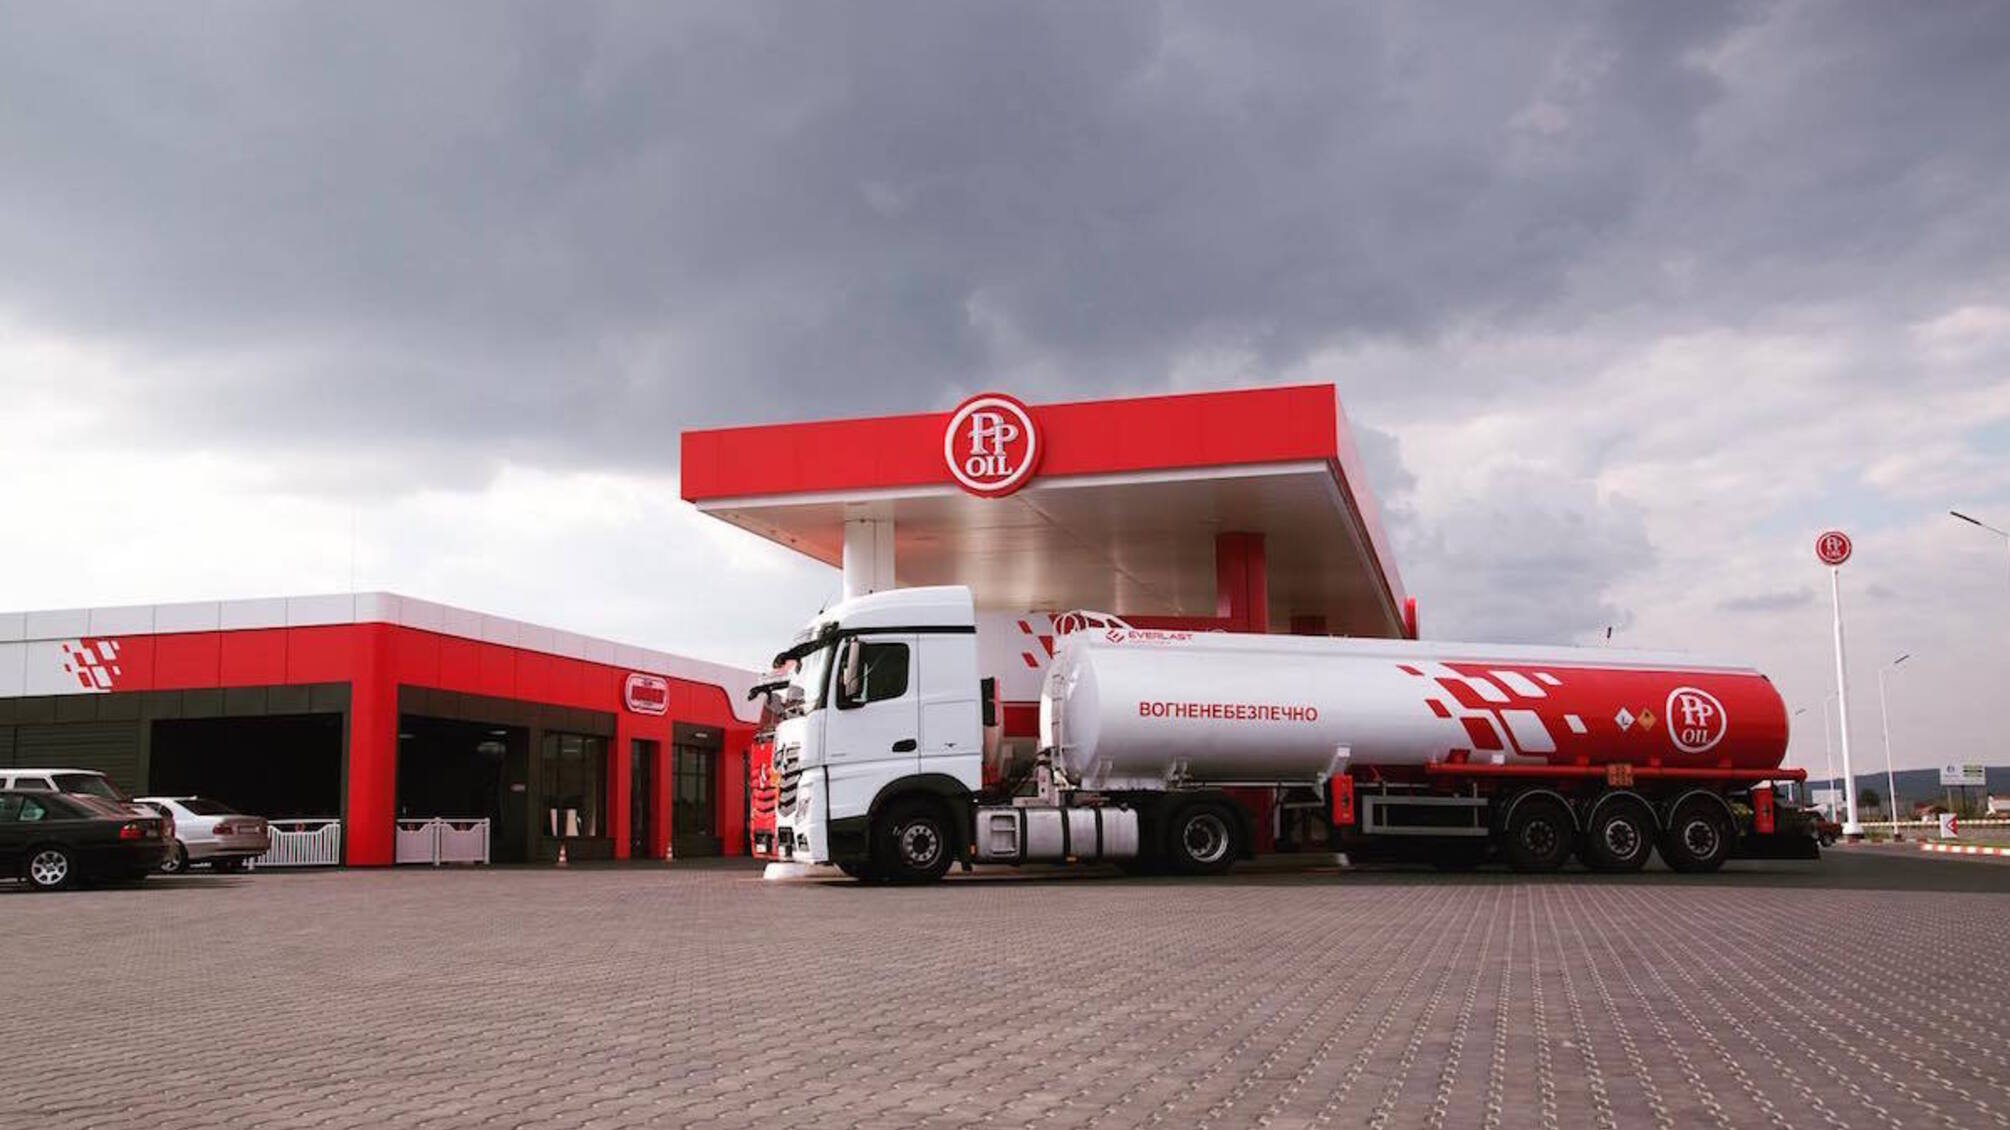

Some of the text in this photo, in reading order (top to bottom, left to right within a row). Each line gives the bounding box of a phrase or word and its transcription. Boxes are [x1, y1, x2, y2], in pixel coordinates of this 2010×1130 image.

[965, 455, 1013, 477] OIL
[1128, 631, 1192, 640] EVERLAST
[1139, 702, 1318, 721] ВОГНЕНЕБЕЗПЕЧНО
[1682, 728, 1710, 744] OIL
